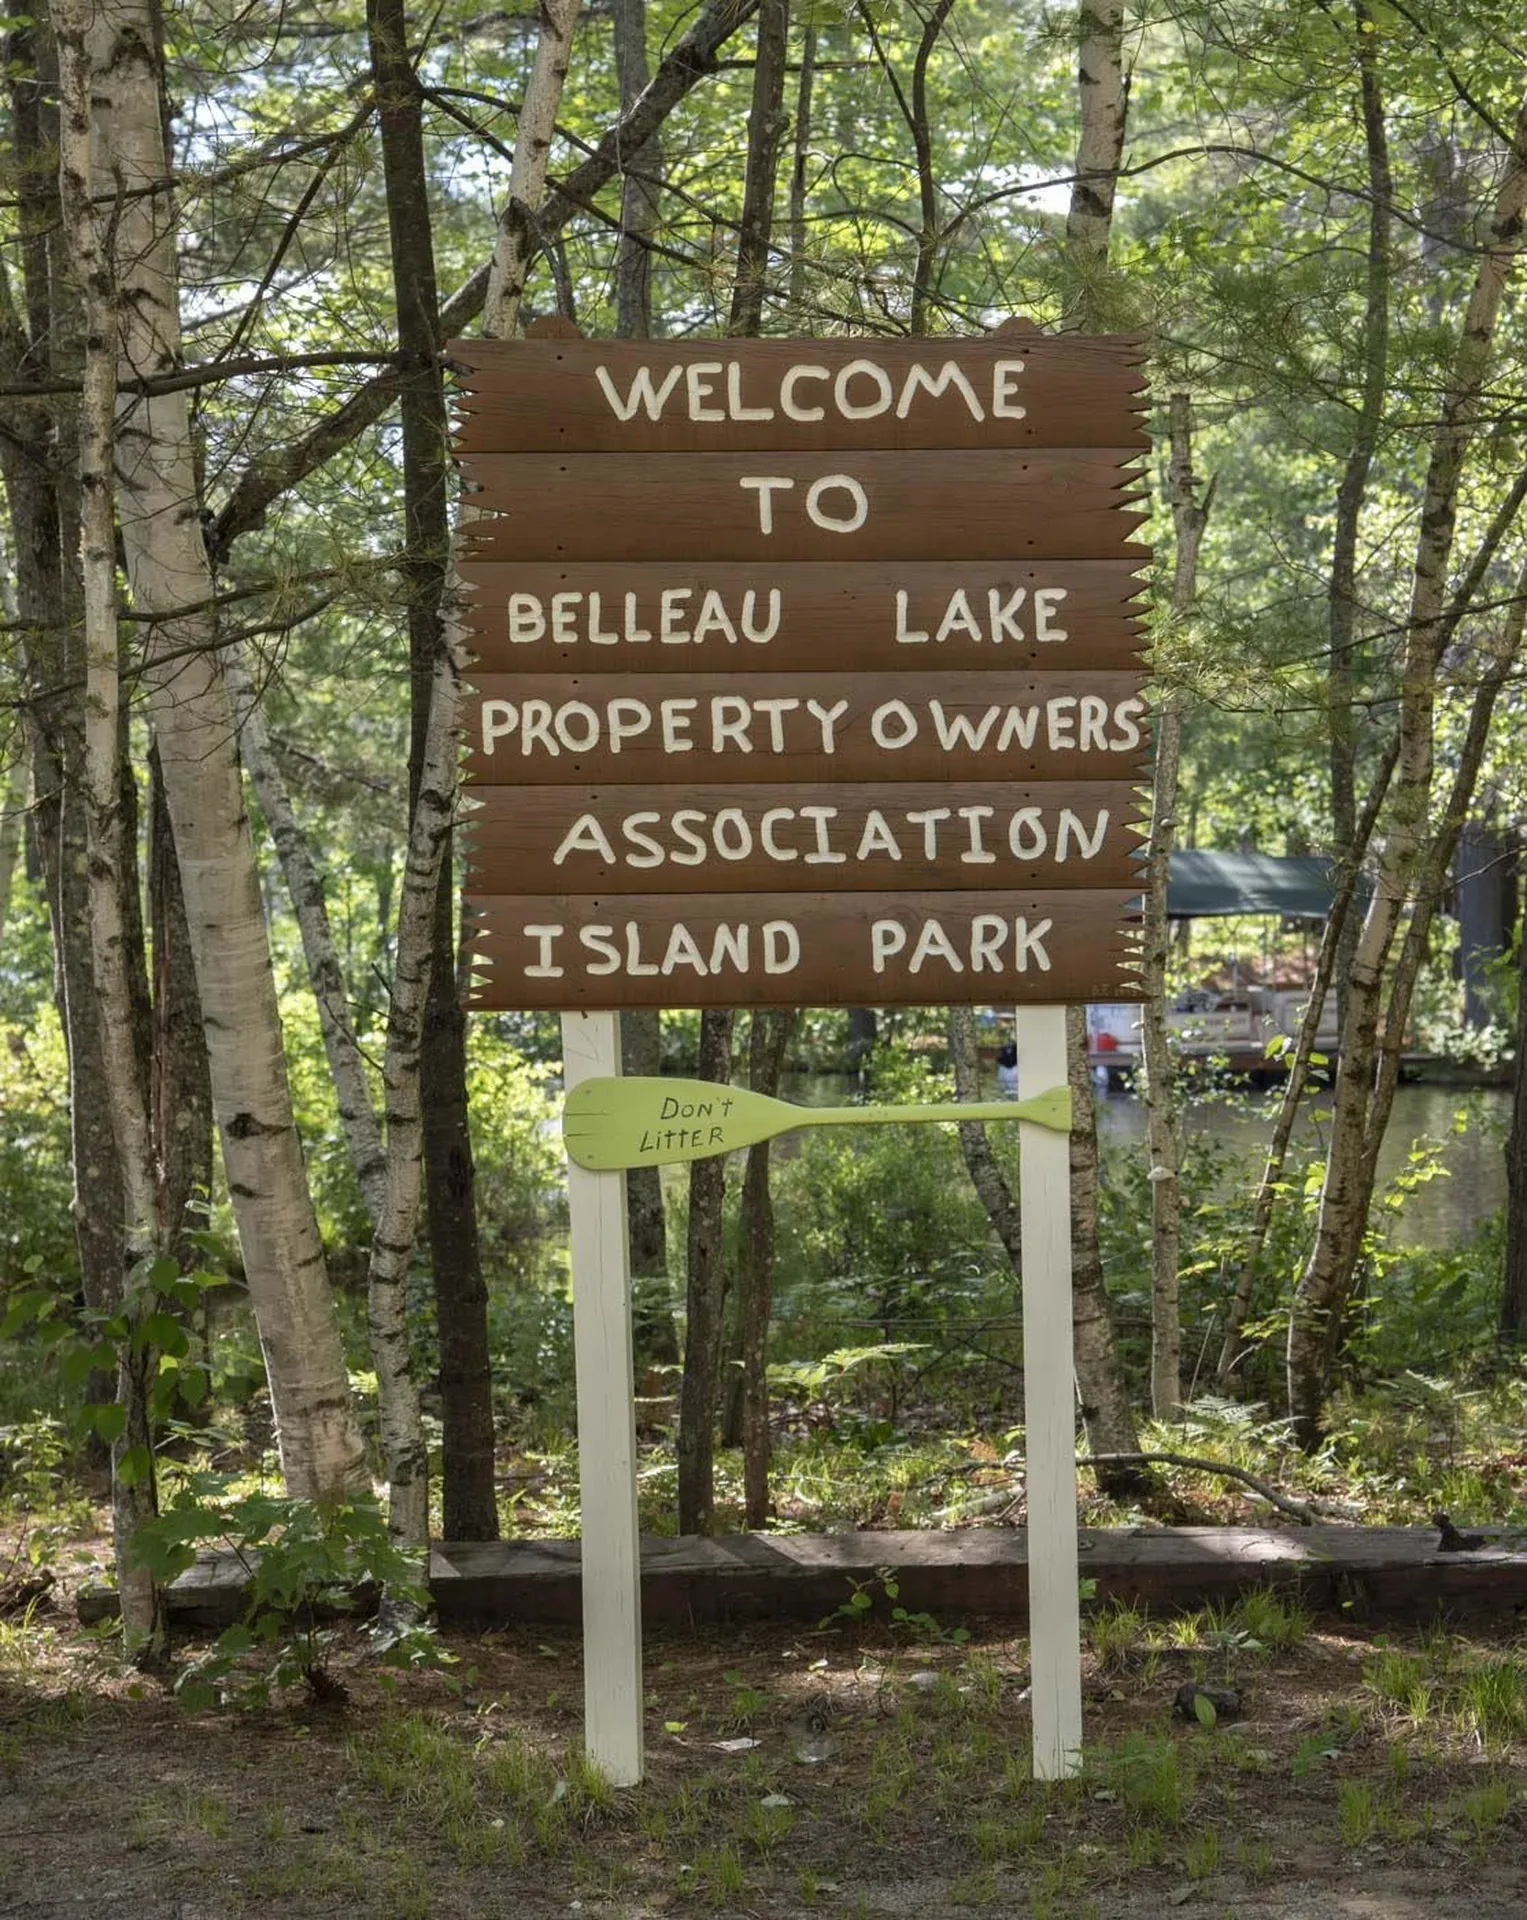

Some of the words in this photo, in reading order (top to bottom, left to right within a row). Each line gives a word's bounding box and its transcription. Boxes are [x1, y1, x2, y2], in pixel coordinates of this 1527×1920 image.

[594, 358, 1027, 423] WELCOME
[738, 473, 869, 535] TO
[508, 587, 781, 645] BELLEAU
[895, 587, 1068, 644] LAKE
[481, 695, 849, 757] PROPERTY
[871, 694, 1145, 752] OWNERS
[552, 805, 1110, 869] ASSOCIATION
[523, 919, 801, 978] ISLAND
[871, 914, 1053, 974] PARK
